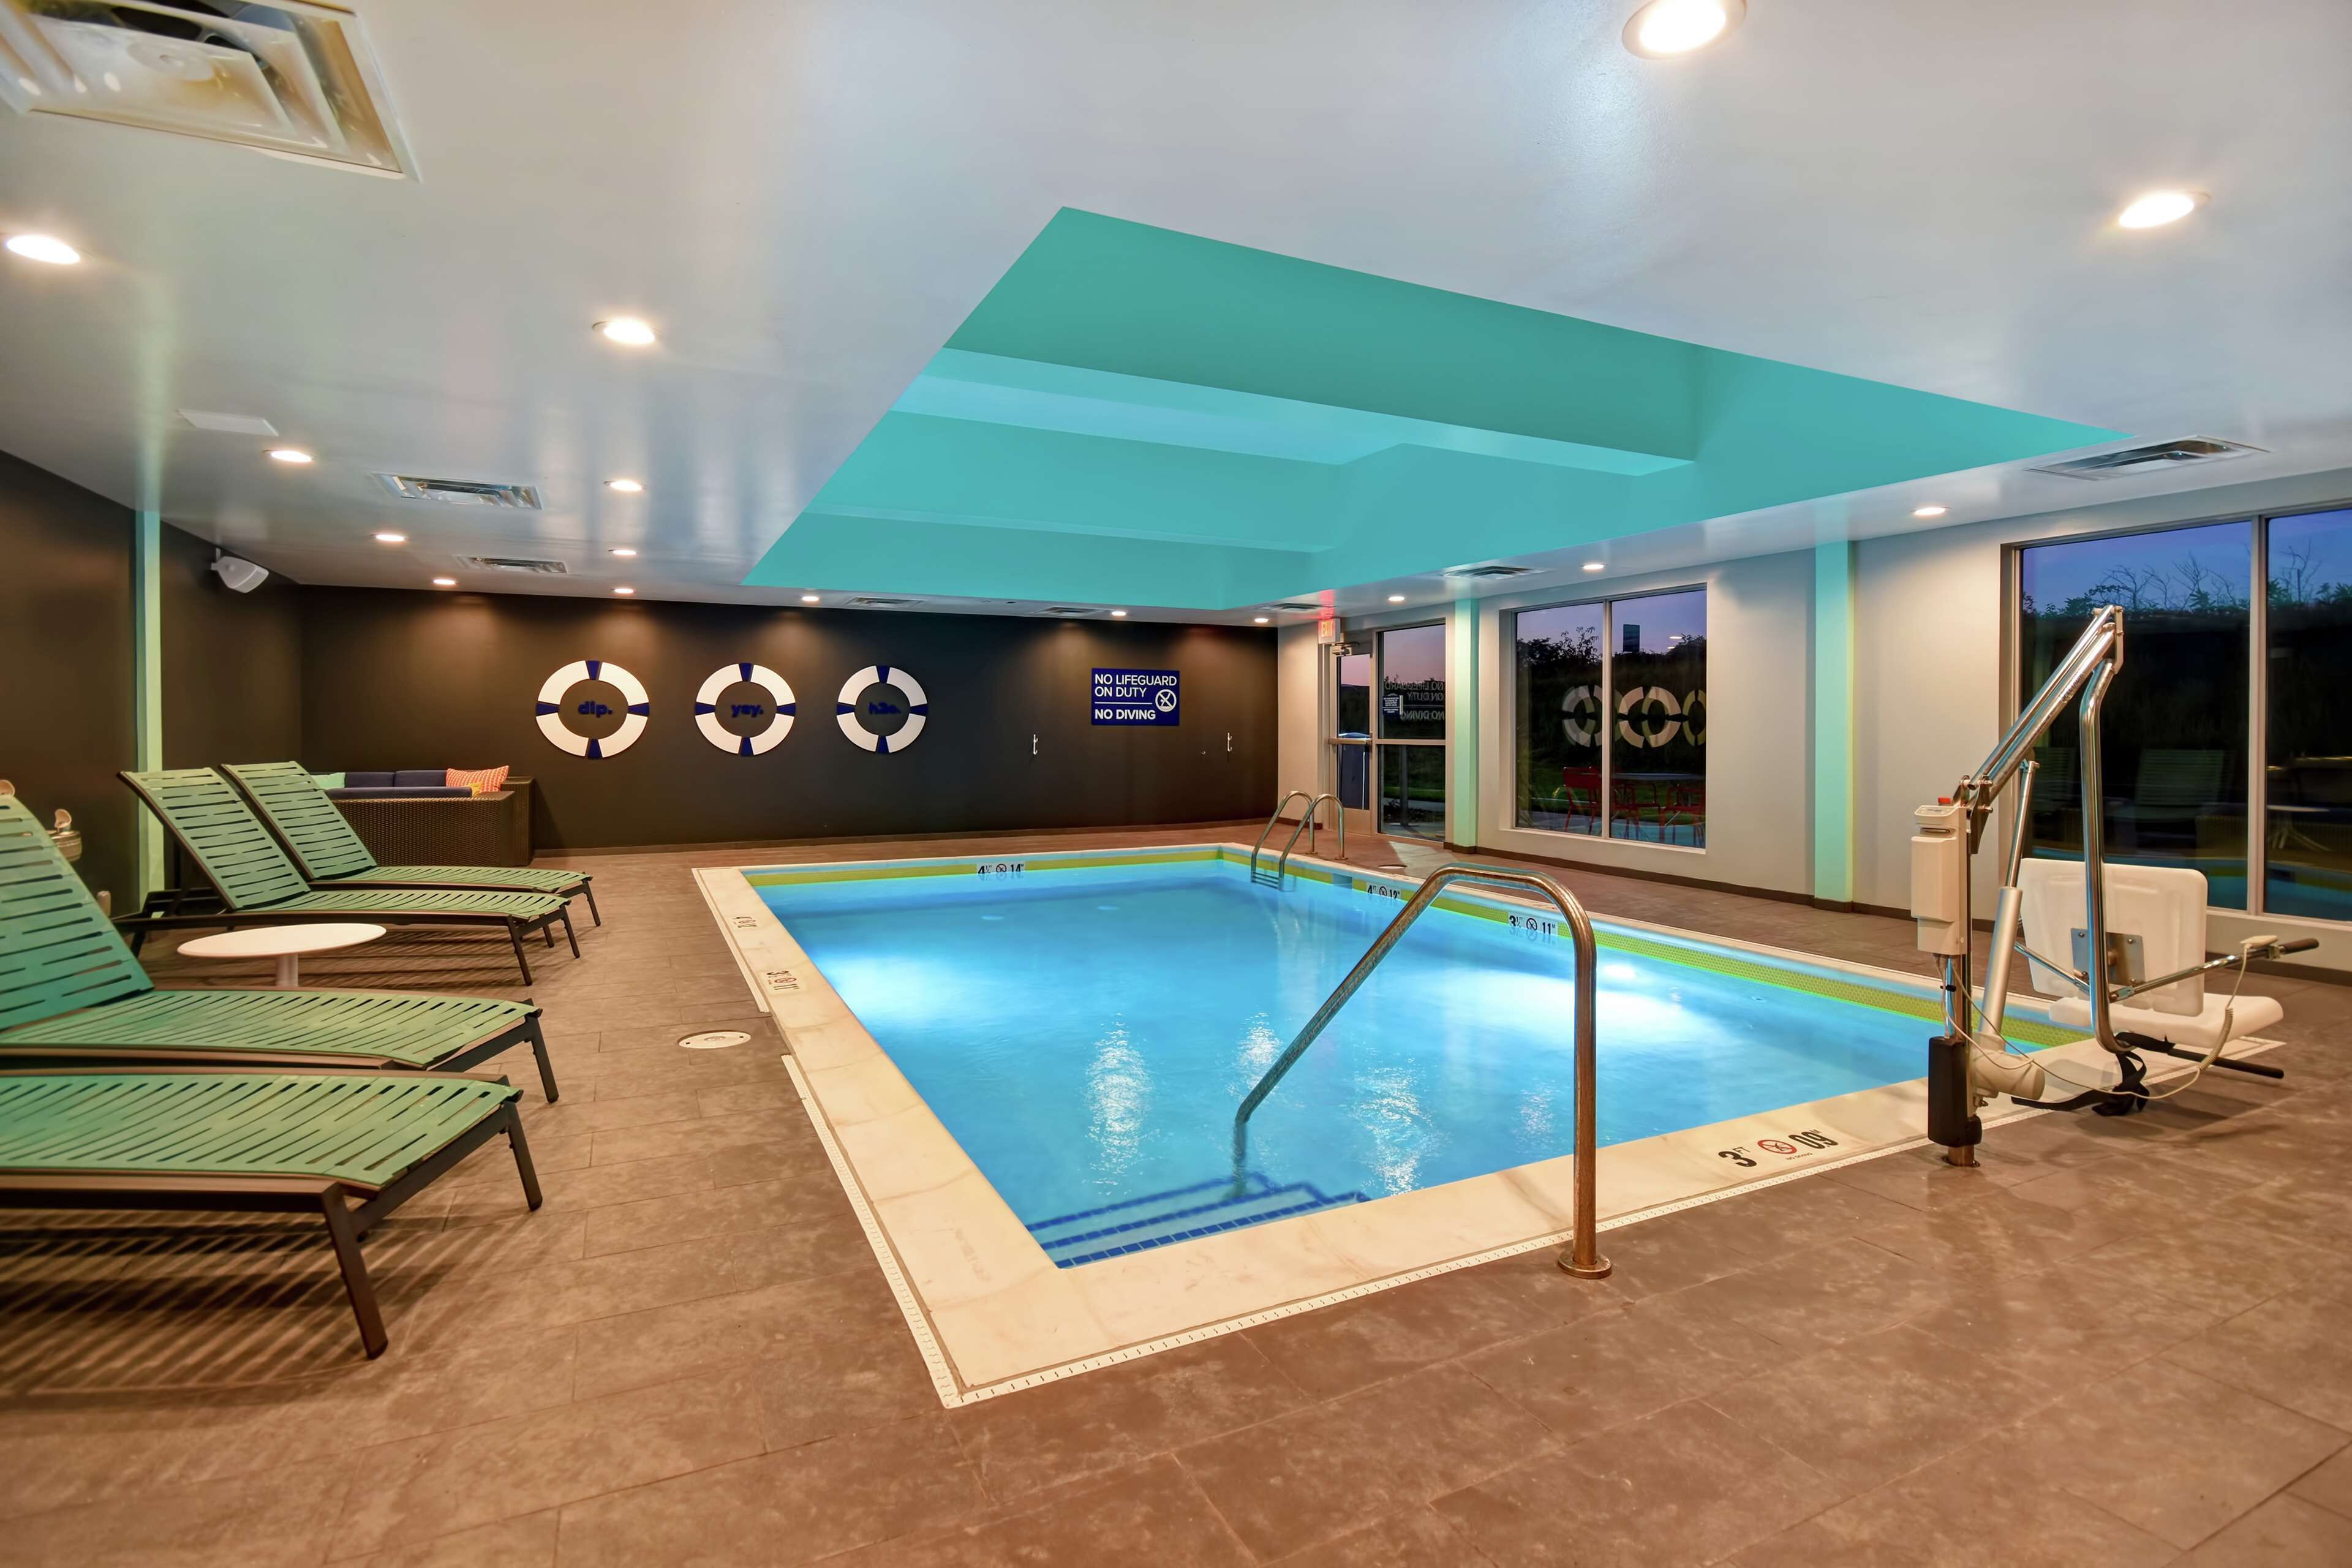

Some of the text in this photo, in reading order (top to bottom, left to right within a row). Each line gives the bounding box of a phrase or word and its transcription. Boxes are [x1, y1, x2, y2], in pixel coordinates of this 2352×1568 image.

[1095, 674, 1177, 686] NO LIFEGUARD
[1095, 686, 1147, 698] ON DUTY
[578, 701, 612, 718] dip.
[731, 704, 764, 718] yay.
[1095, 709, 1156, 720] NO DIVING
